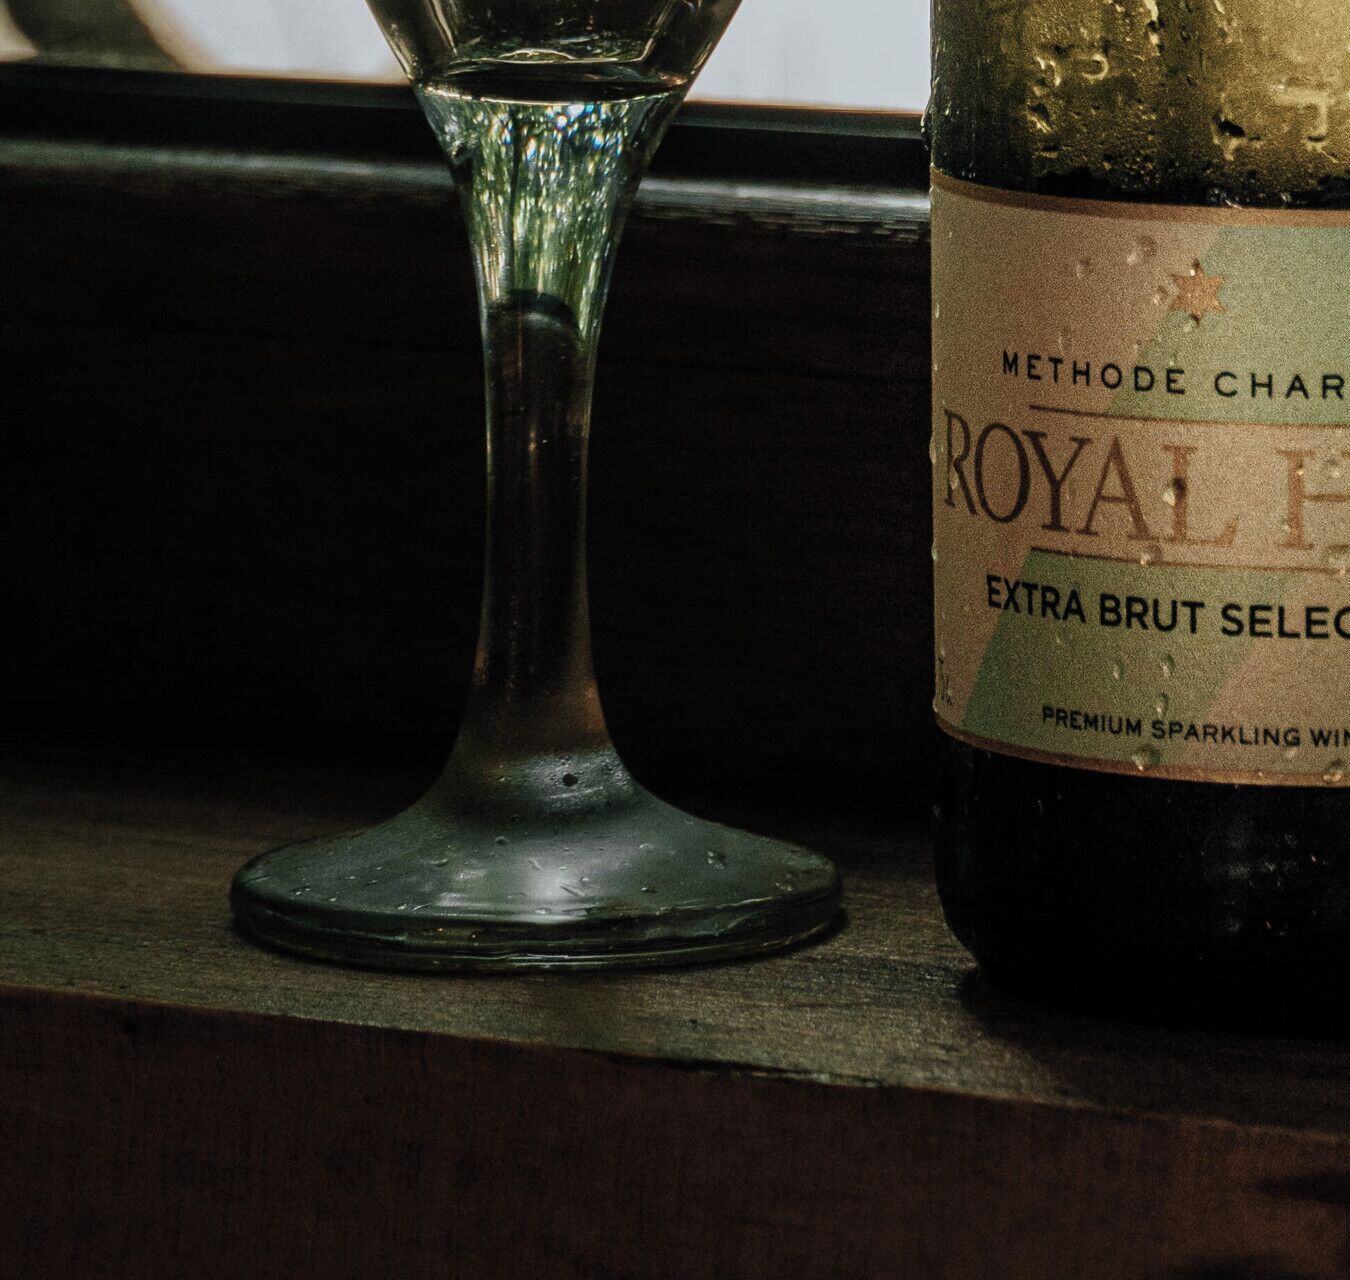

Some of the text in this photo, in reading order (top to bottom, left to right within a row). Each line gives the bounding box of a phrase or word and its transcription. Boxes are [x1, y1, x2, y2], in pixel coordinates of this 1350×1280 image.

[1002, 350, 1186, 395] METHODE
[943, 407, 1240, 546] ROYAL
[986, 575, 1086, 624] EXTRA
[1099, 594, 1205, 634] BRUT
[1042, 705, 1142, 737] PREMIUM
[1151, 719, 1301, 748] SPARKLING
